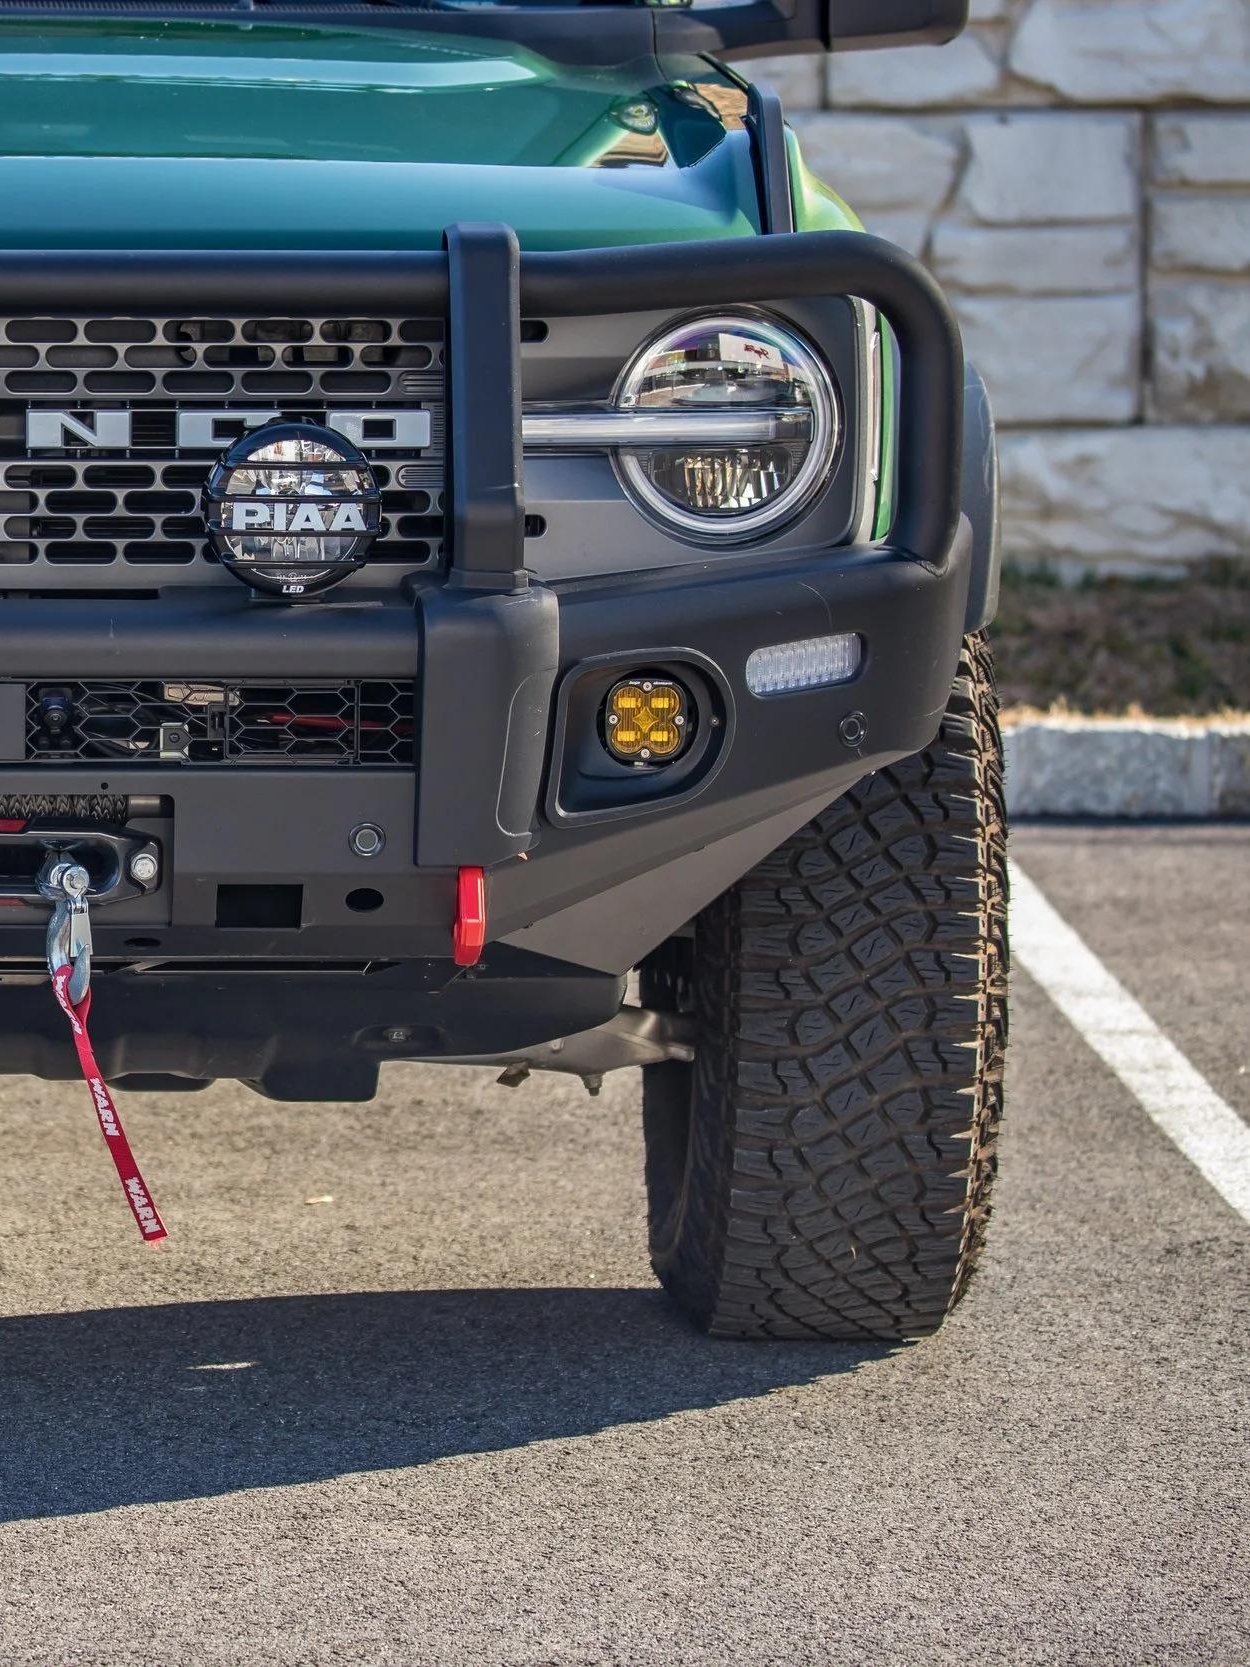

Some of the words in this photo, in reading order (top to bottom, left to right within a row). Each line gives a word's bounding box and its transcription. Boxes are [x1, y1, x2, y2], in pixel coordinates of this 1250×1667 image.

[232, 503, 367, 531] PIAA
[282, 585, 305, 593] LED
[89, 1077, 121, 1137] WARN
[125, 1176, 162, 1234] WARN
